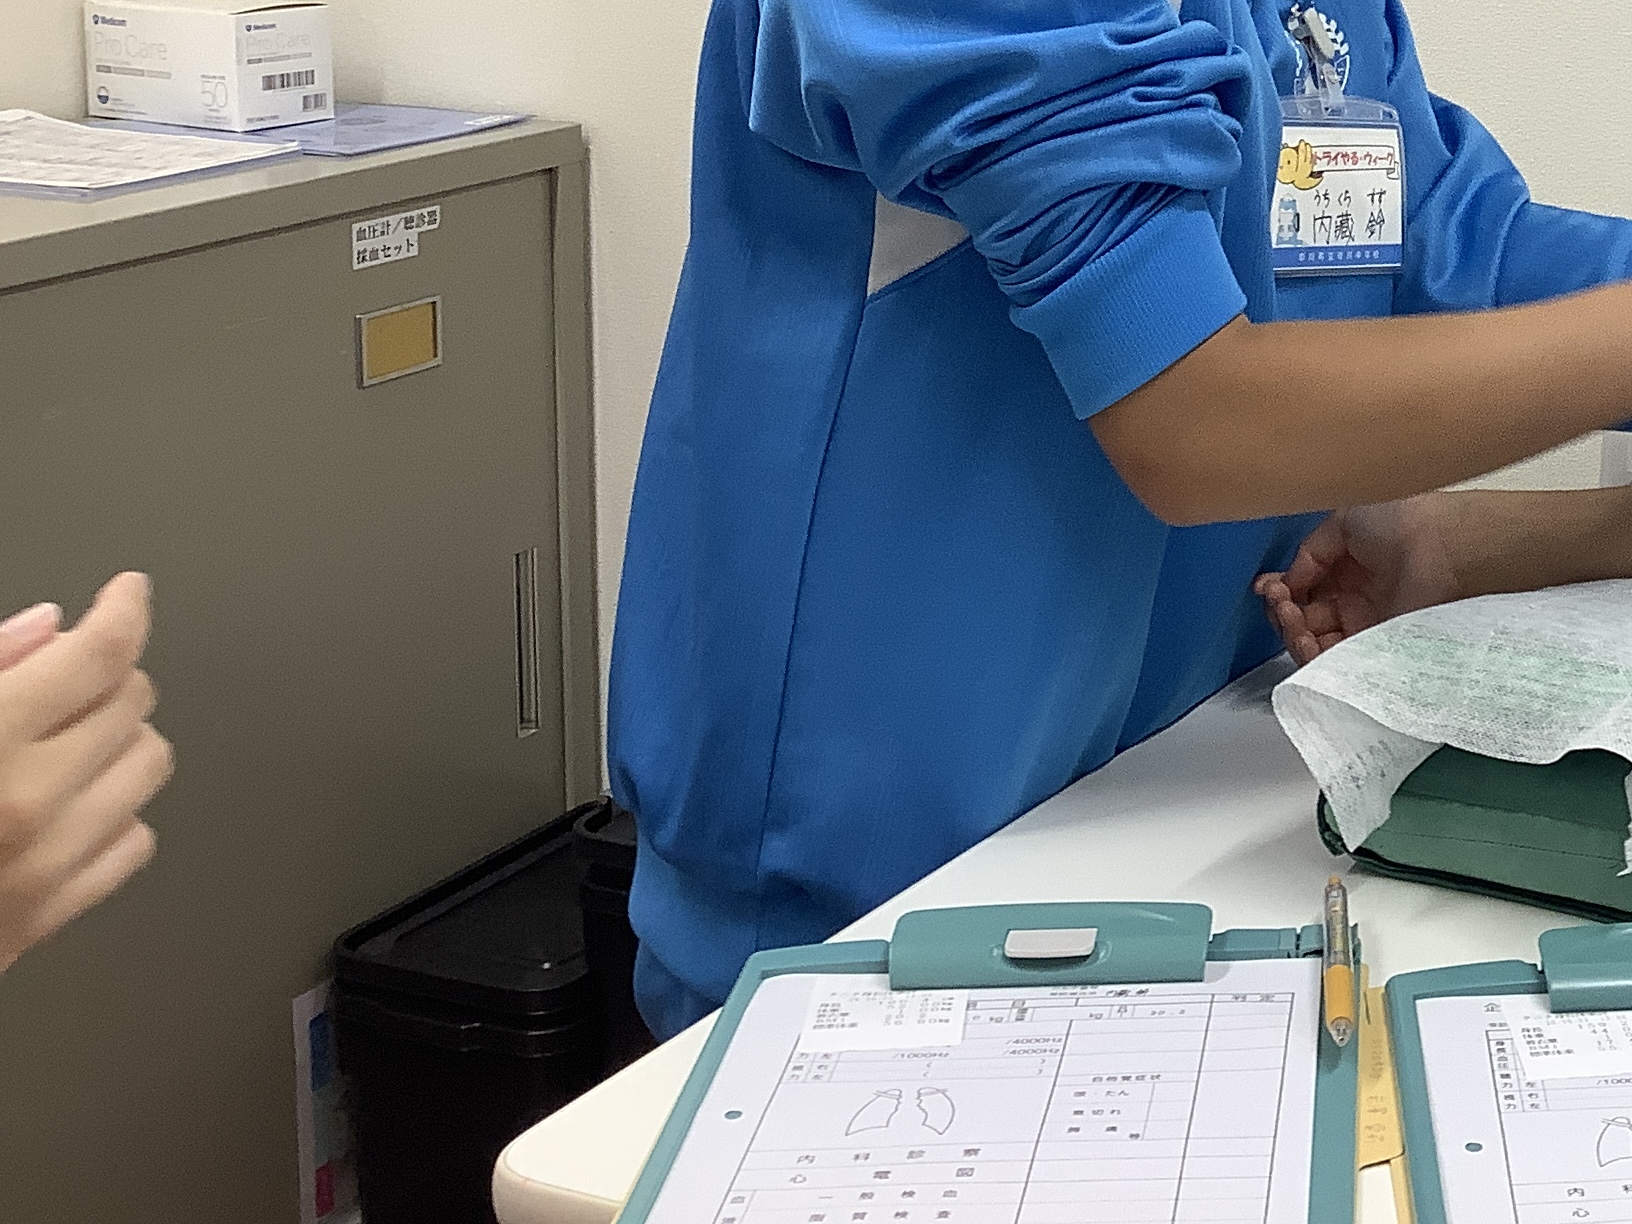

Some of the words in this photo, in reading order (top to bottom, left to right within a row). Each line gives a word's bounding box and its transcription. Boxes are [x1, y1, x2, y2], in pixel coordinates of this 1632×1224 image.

[201, 81, 228, 109] 50
[356, 237, 415, 265] 採血セット
